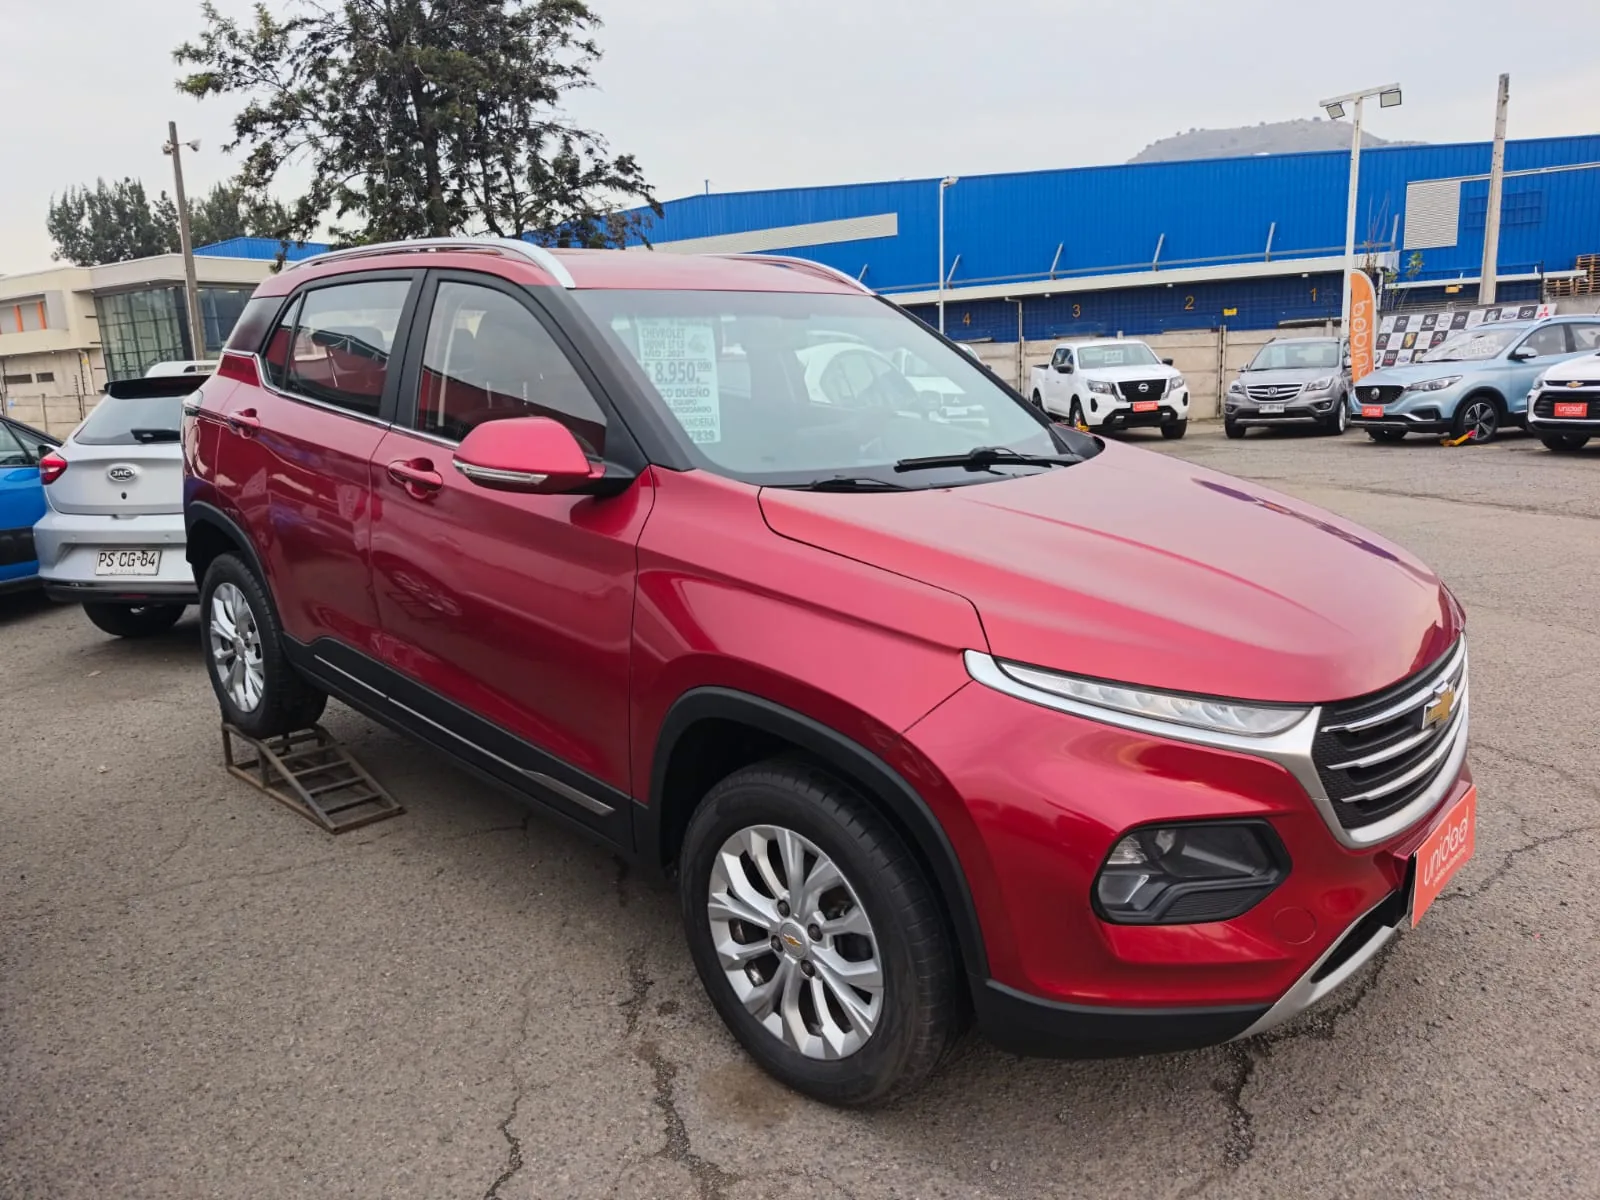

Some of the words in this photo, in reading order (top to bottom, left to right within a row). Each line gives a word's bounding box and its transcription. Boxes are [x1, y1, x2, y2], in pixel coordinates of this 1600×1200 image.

[1309, 287, 1317, 302] 1
[1184, 296, 1194, 310] 2
[1072, 304, 1081, 318] 3
[963, 312, 971, 327] 4
[642, 328, 685, 339] CHEVROLET
[675, 386, 710, 398] DUEÑO
[1423, 805, 1470, 886] unidad
